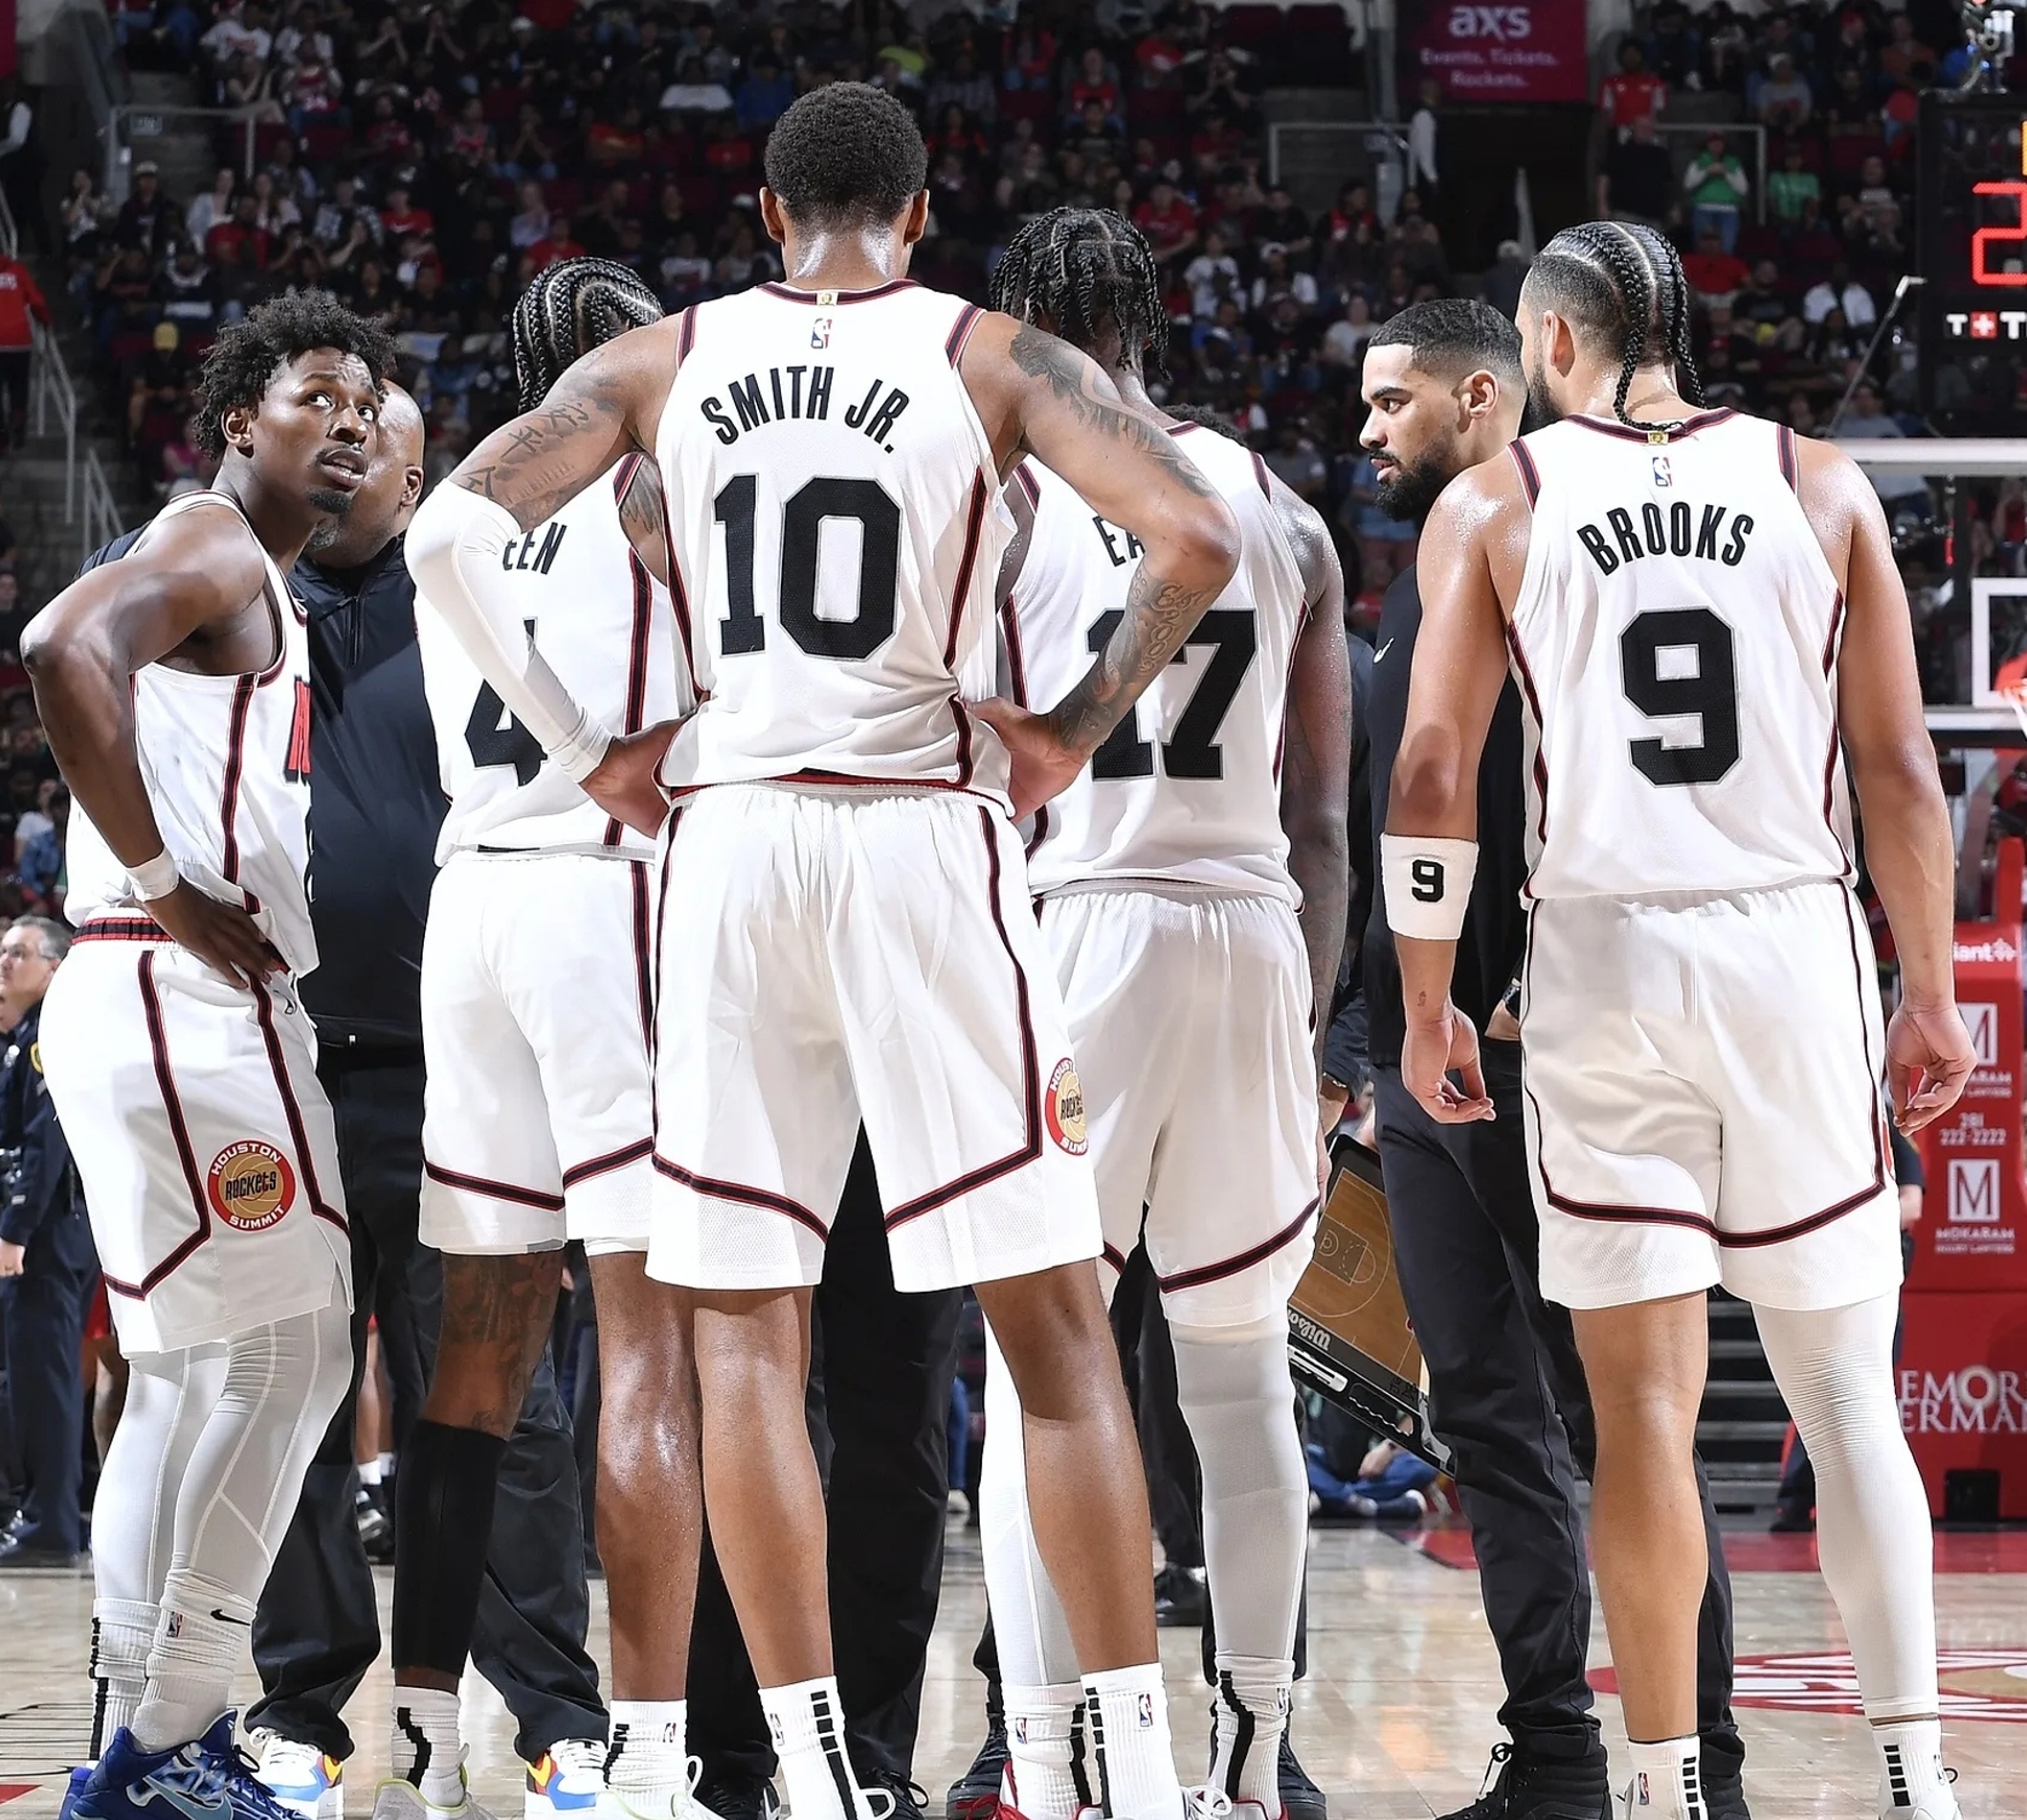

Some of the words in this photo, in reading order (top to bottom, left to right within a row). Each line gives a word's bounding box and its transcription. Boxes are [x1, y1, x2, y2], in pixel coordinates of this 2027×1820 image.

[1449, 5, 1531, 43] axs
[701, 366, 835, 445] SMITH
[844, 378, 910, 455] JR.
[712, 473, 902, 662] 10
[1576, 501, 1755, 576] BROOKS
[1086, 609, 1258, 782] 17
[1618, 606, 1742, 788] 9
[1412, 858, 1444, 903] 9
[211, 1143, 281, 1176] HOUSTON
[1956, 1165, 1992, 1215] M
[229, 1204, 284, 1230] SUMMIT
